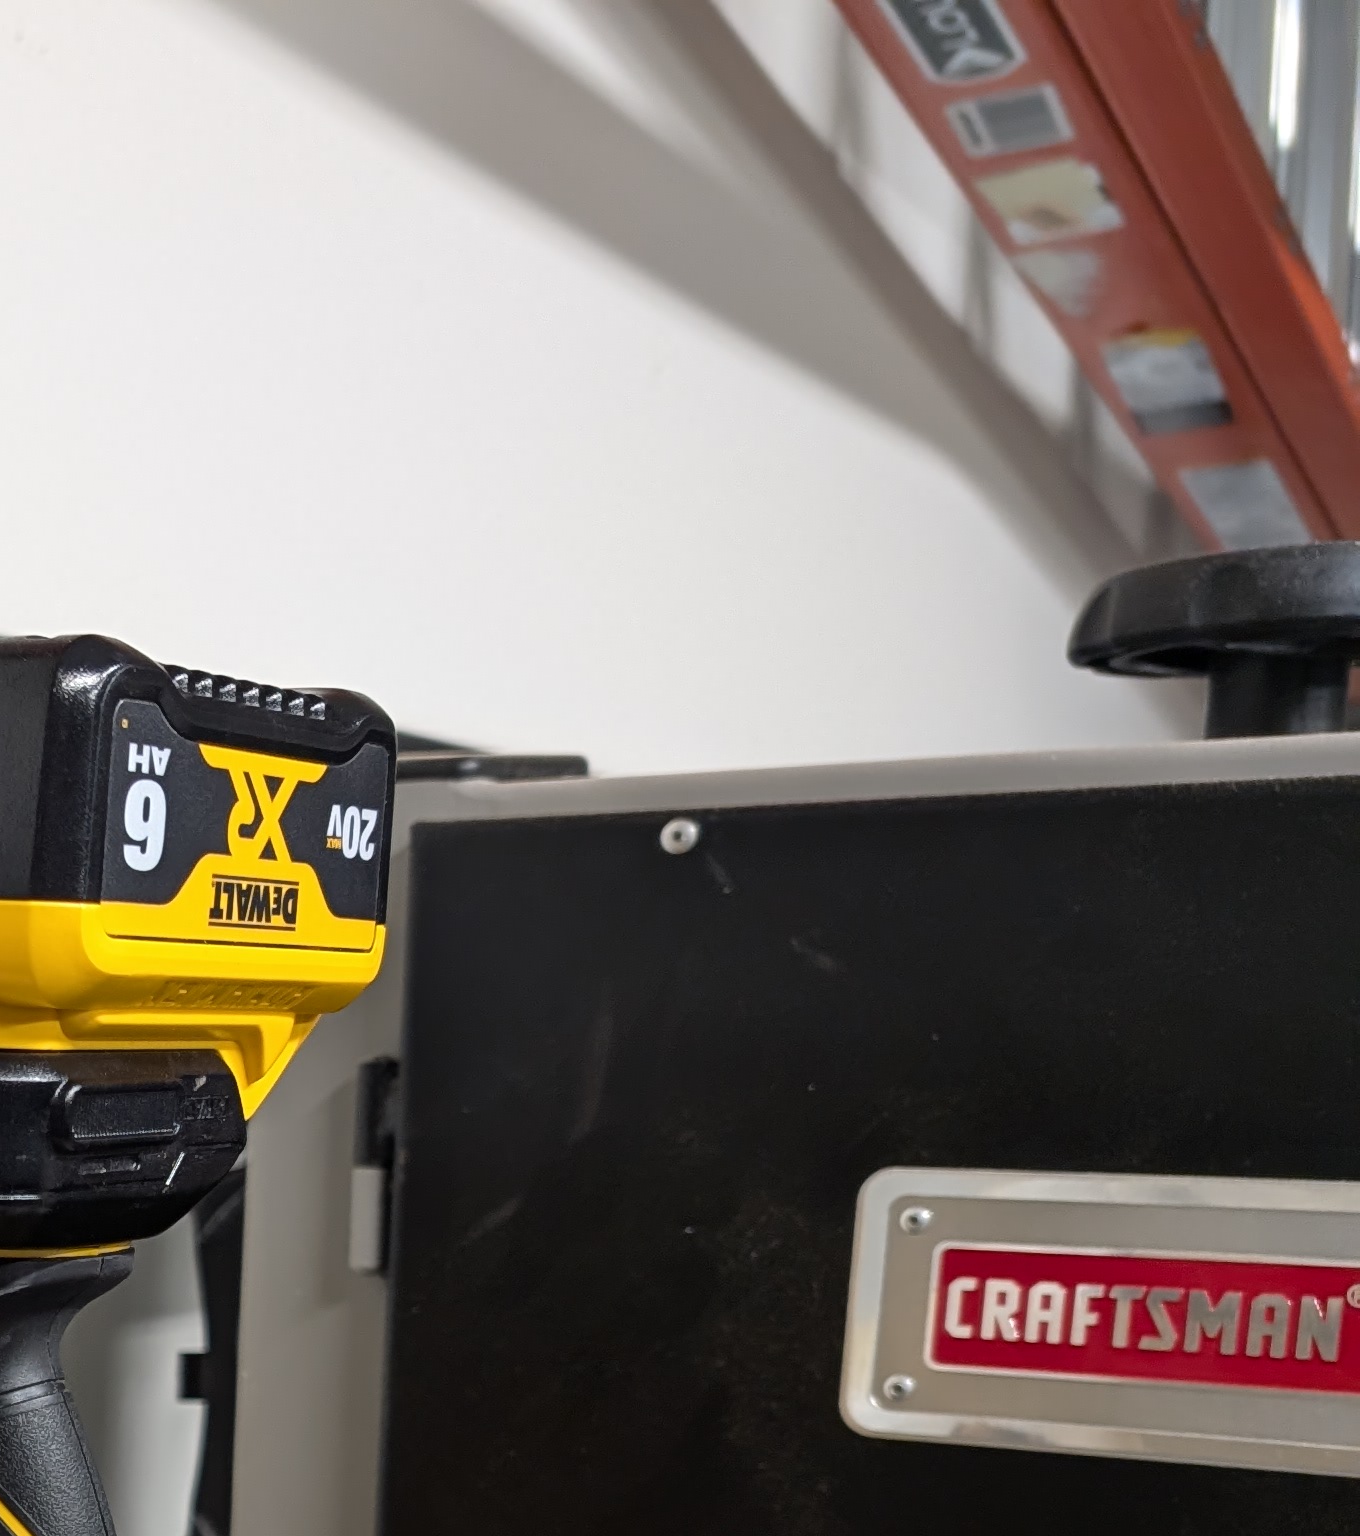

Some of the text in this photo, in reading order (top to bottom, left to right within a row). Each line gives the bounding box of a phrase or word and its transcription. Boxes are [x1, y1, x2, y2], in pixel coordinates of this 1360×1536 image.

[128, 743, 171, 776] AH
[123, 779, 167, 872] 6
[222, 766, 300, 866] XR
[326, 803, 379, 862] 20V
[944, 1277, 1345, 1363] CRAFTSMAN
